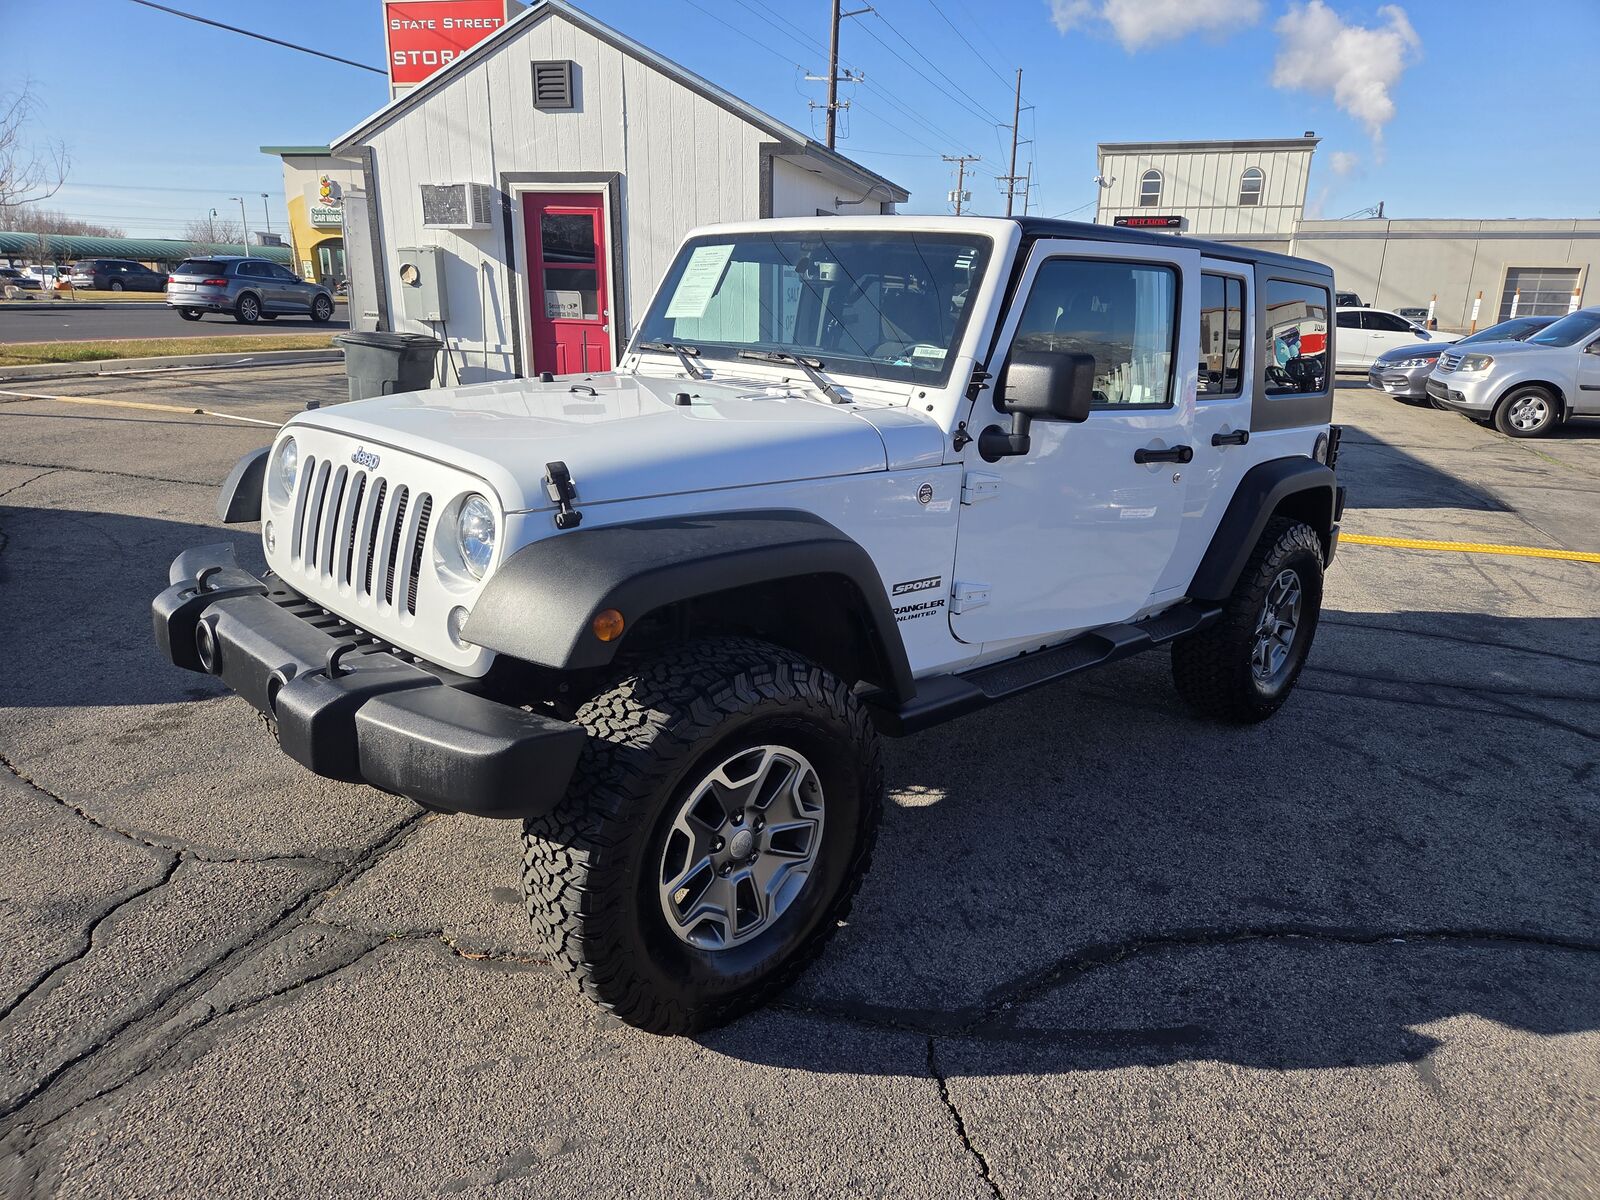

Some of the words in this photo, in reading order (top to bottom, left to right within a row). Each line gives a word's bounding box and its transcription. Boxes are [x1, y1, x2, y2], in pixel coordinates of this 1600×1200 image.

[393, 49, 466, 66] STOR
[313, 214, 326, 222] CAR
[351, 445, 381, 472] Jeep
[894, 579, 941, 594] SPORT
[892, 599, 945, 615] RANGLER
[896, 609, 937, 623] NLIMITED
